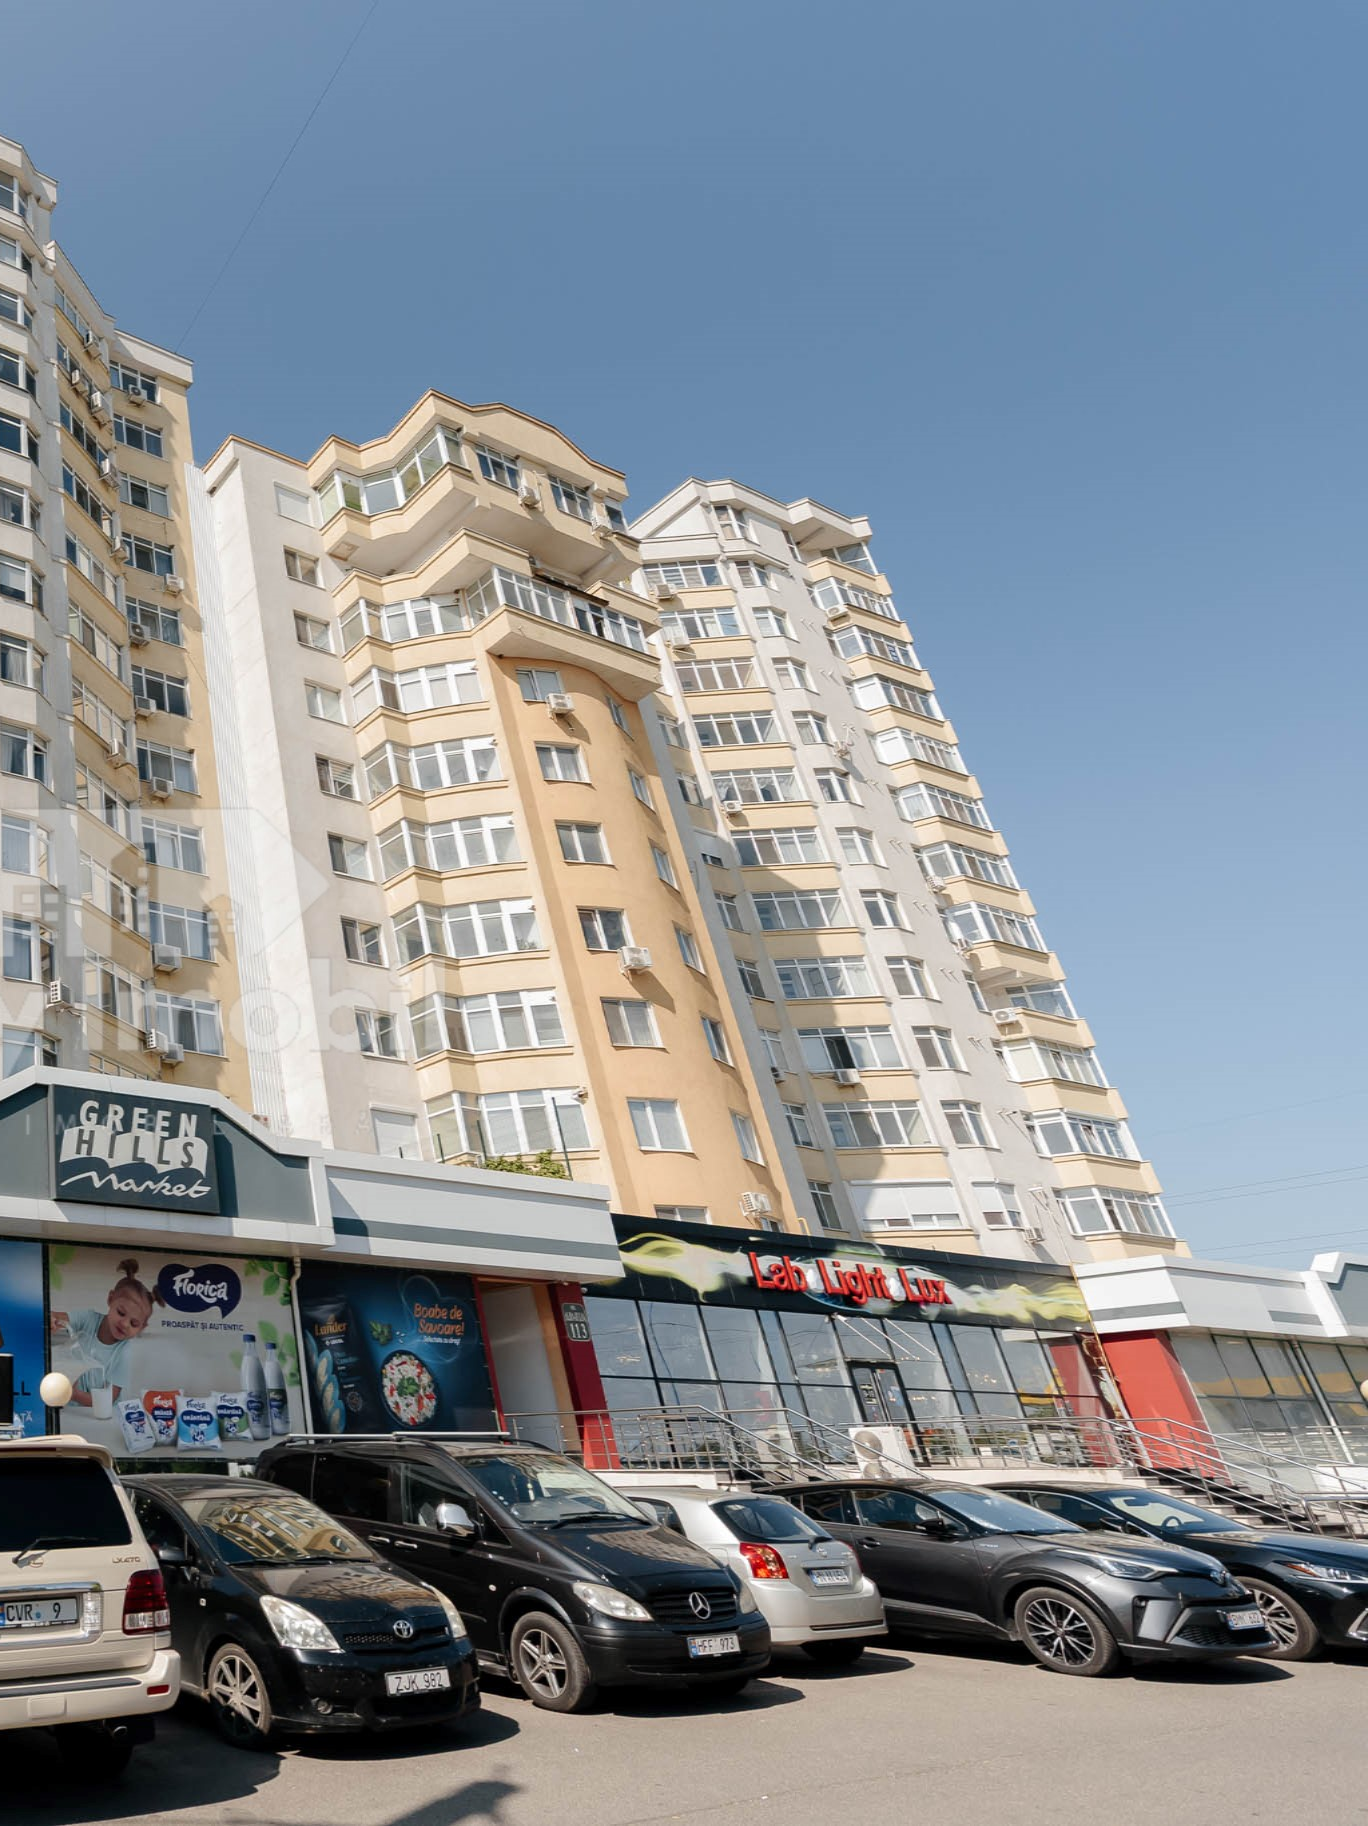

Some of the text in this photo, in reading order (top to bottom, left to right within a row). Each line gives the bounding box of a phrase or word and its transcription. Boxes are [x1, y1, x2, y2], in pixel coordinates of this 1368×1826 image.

[79, 1100, 198, 1138] GREEN
[75, 1129, 195, 1168] HILLS
[748, 1251, 953, 1305] Lab Light Lux
[414, 1303, 463, 1320] Boabe de
[209, 1323, 244, 1331] AUTENTIC
[418, 1319, 465, 1336] Savoare!
[569, 1323, 588, 1339] 113
[6, 1602, 61, 1622] CVR 9
[719, 1637, 735, 1651] 973
[394, 1674, 419, 1692] ZJK
